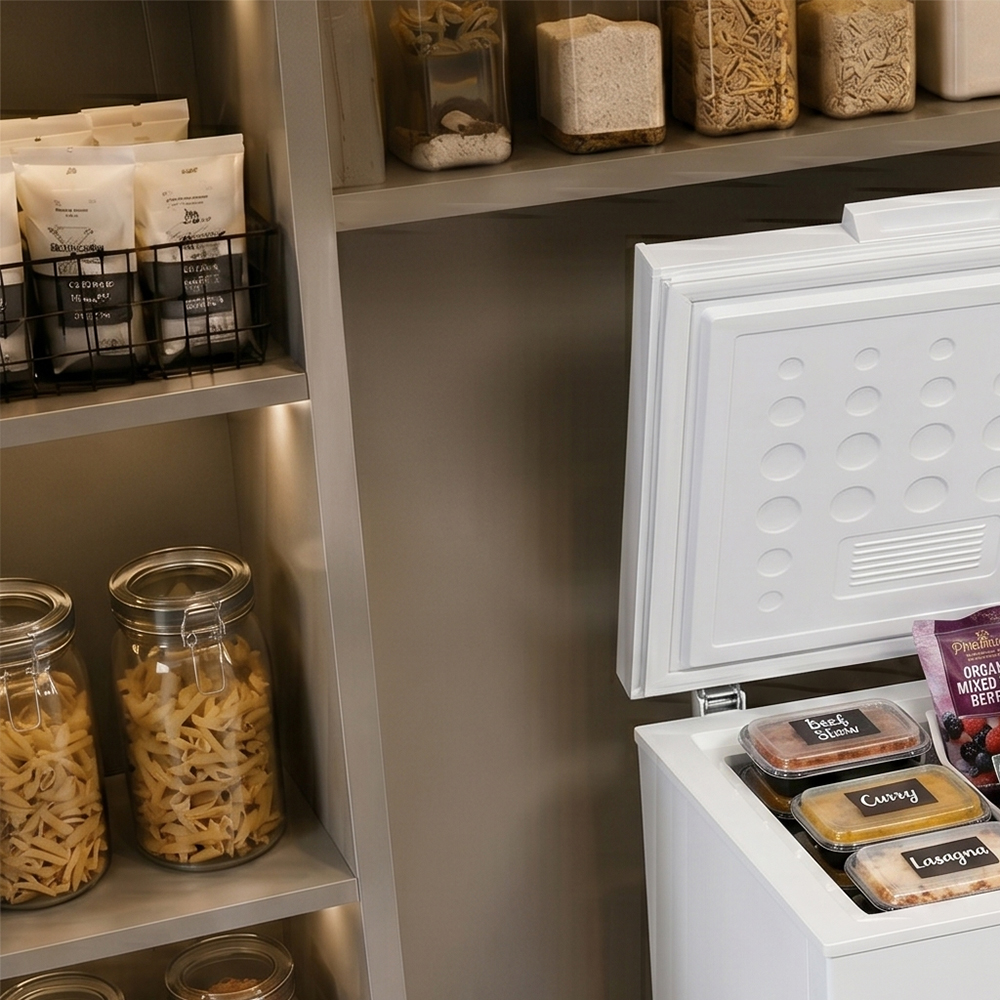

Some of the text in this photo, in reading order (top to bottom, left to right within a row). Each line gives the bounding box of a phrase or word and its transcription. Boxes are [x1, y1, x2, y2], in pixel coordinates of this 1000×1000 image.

[956, 676, 997, 695] MIXED
[860, 789, 918, 807] Curry
[909, 845, 989, 869] Lasagna
